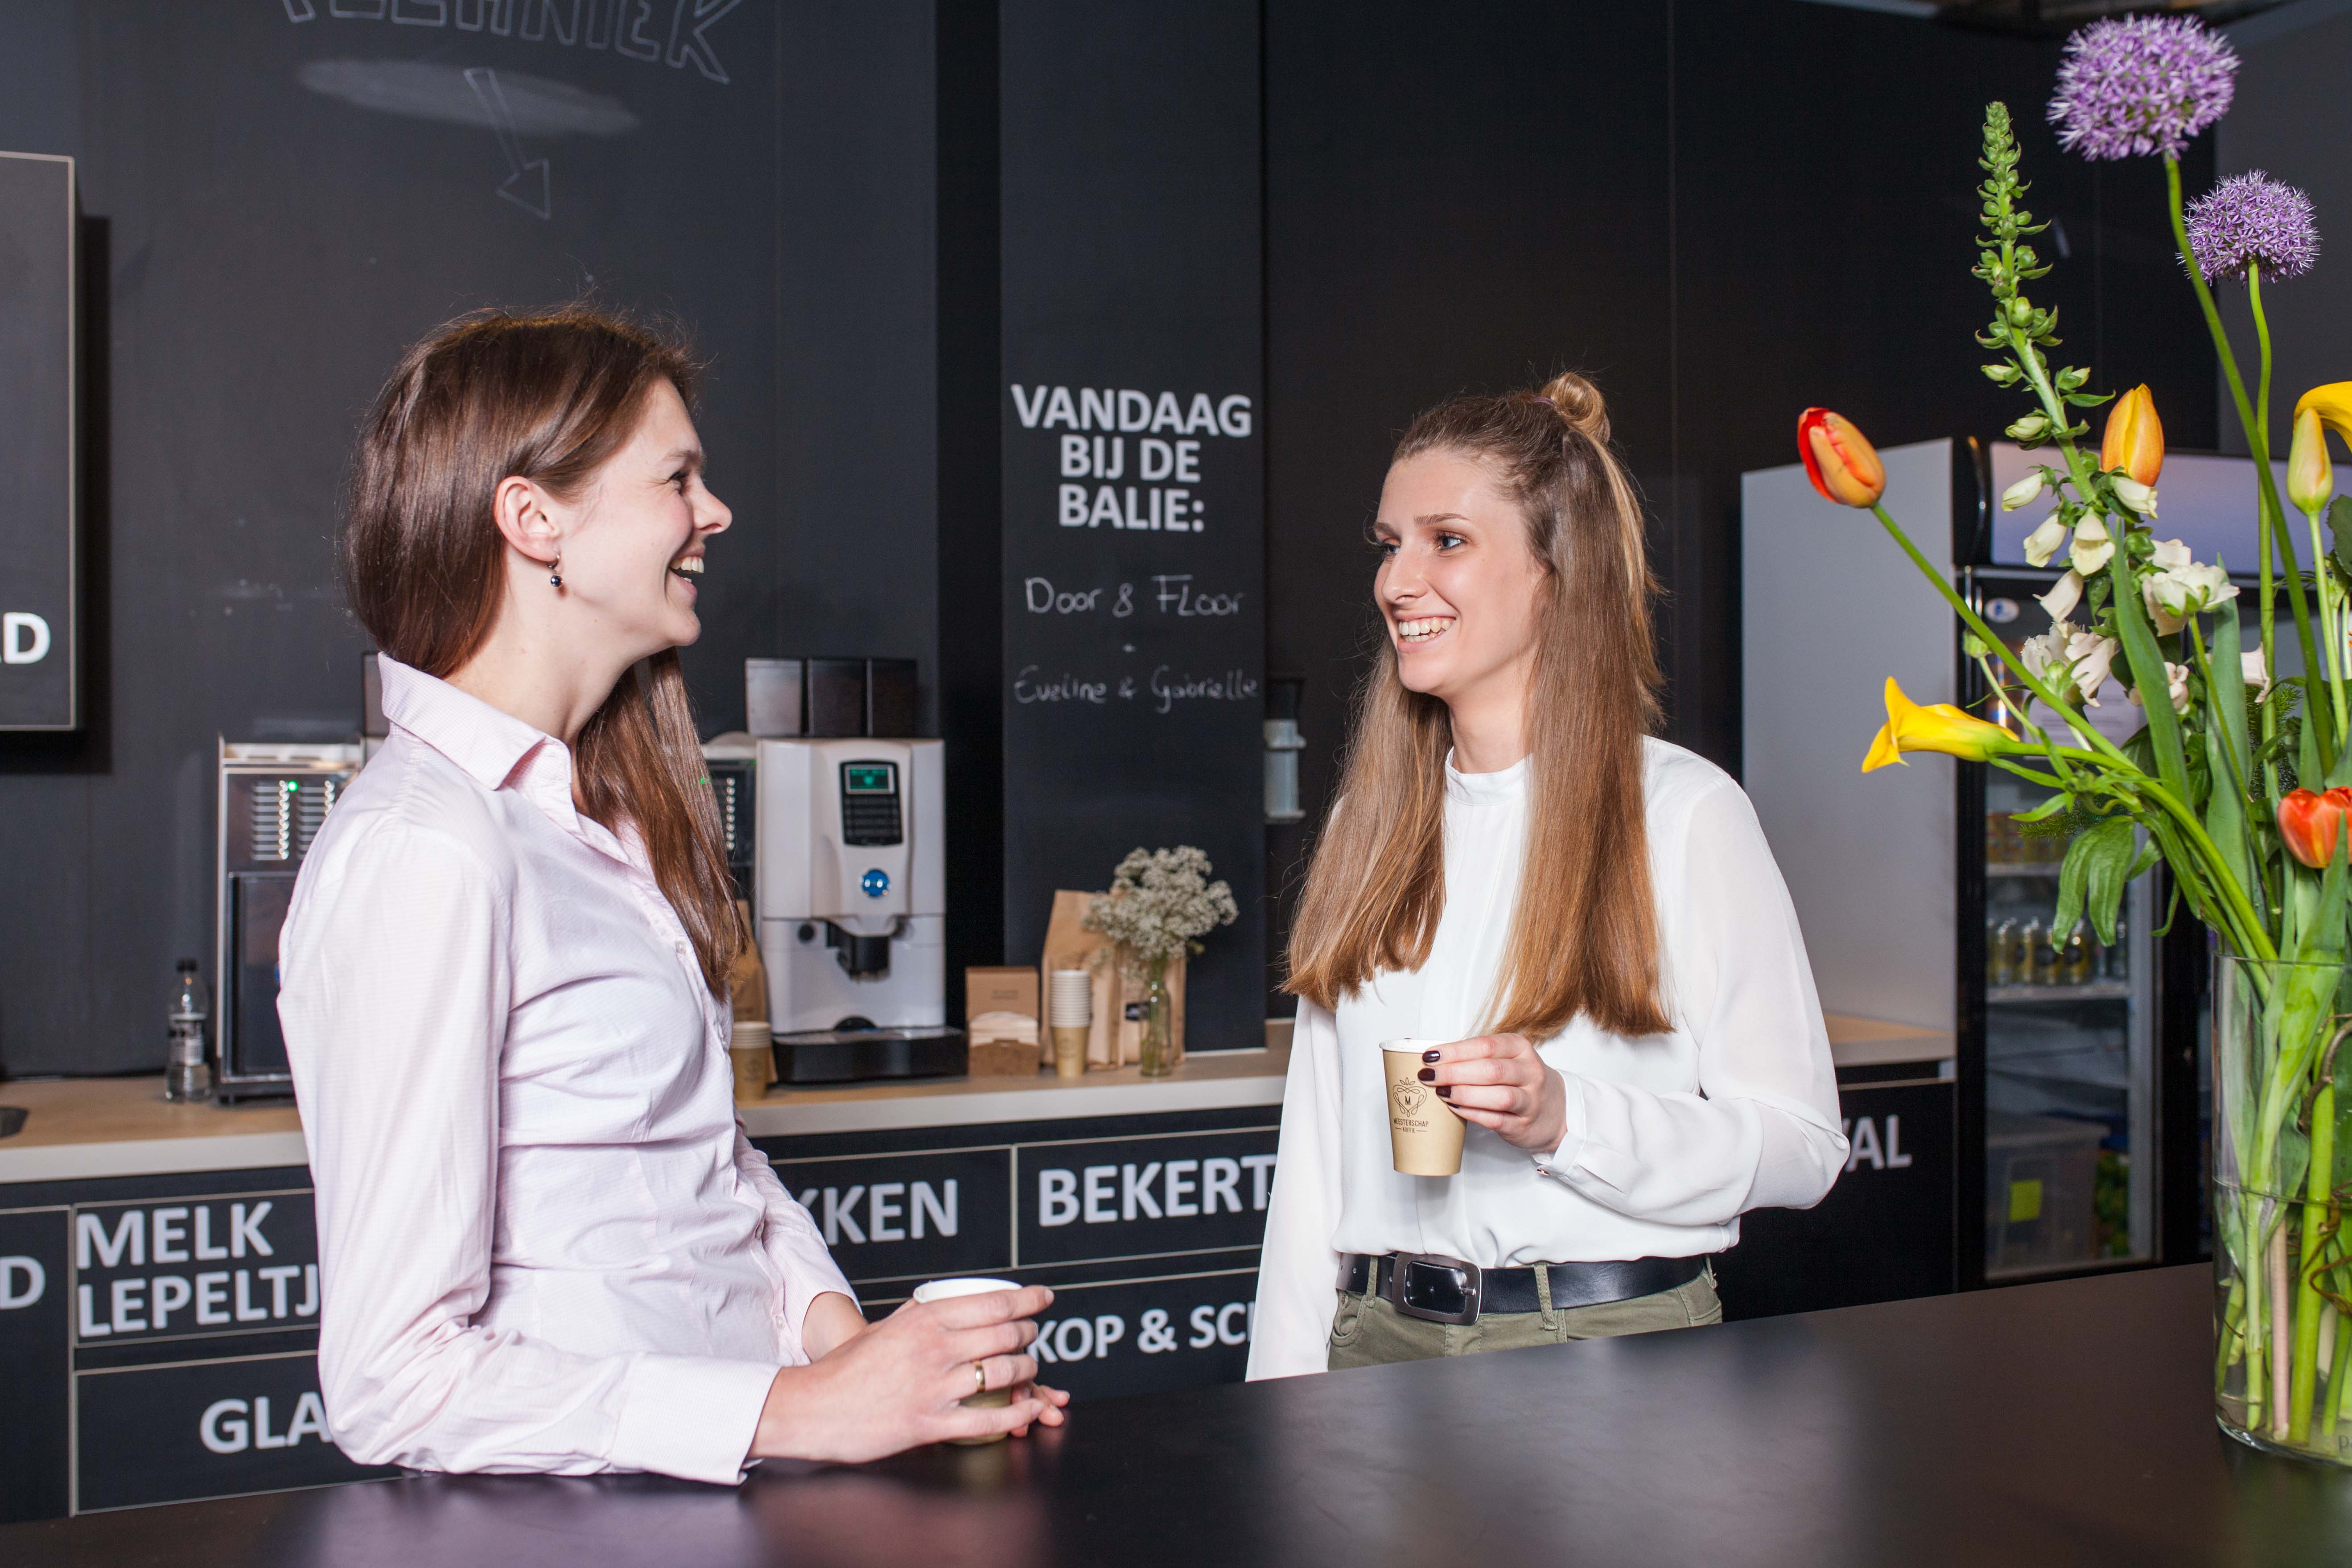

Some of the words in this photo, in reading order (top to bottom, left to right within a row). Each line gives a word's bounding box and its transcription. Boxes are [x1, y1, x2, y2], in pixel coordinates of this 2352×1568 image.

[1011, 384, 1252, 438] VANDAAG
[1061, 434, 1125, 480] BIJ
[1140, 438, 1201, 483] DE
[1059, 484, 1204, 533] BALIE:
[1025, 576, 1103, 614] Door
[1112, 583, 1134, 618] &
[0, 611, 51, 664] D
[1013, 664, 1108, 704] Eveline
[1150, 664, 1258, 714] Gabrielle
[1393, 1117, 1429, 1128] MEESTERSCHAP
[1405, 1095, 1411, 1106] M
[1842, 1114, 1913, 1173] AL
[799, 1178, 958, 1246] KEN
[1039, 1153, 1277, 1227] BEKERT
[76, 1201, 274, 1270] MELK
[78, 1263, 320, 1337] LEPELTJ
[1026, 1314, 1125, 1364] KOP
[1137, 1308, 1178, 1354] &
[200, 1391, 333, 1454] GLA
